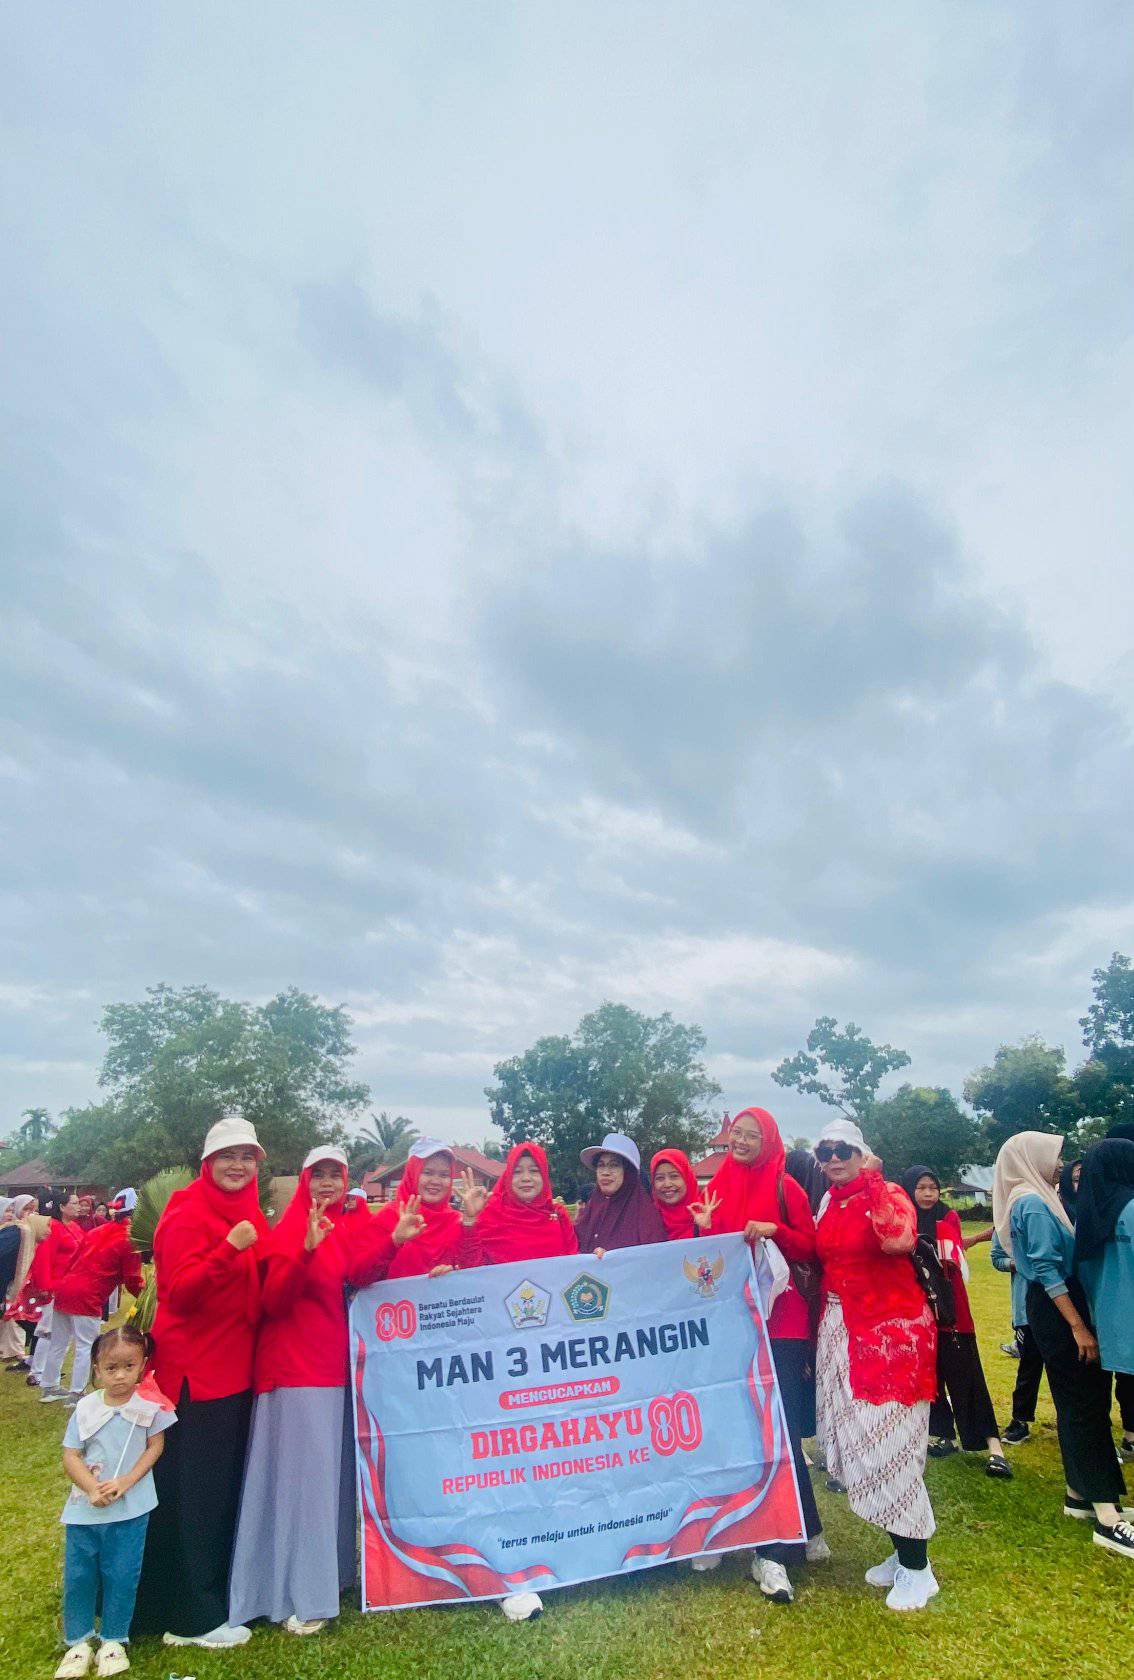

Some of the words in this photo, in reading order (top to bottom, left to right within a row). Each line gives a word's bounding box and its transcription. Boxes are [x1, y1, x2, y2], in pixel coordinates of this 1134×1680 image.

[376, 1300, 417, 1342] 80
[418, 1301, 448, 1312] Bersatu
[449, 1295, 485, 1307] Berdaulat
[419, 1311, 445, 1321] Rakyat
[446, 1306, 482, 1319] Sejahtera
[420, 1319, 456, 1331] Indonesia
[457, 1317, 475, 1328] Maju
[416, 1350, 495, 1391] MAN
[506, 1346, 529, 1378] 3
[540, 1317, 710, 1373] MERANGIN
[508, 1380, 612, 1406] MENGUCAPKAN
[471, 1407, 643, 1460] DIRGAHAYU
[648, 1390, 703, 1457] 80
[442, 1467, 527, 1495] REPUBLIK
[532, 1451, 624, 1481] INDONESIA
[628, 1446, 651, 1465] KE
[531, 1531, 565, 1545] melaju
[567, 1523, 595, 1538] untuk
[597, 1514, 644, 1533] indonesia
